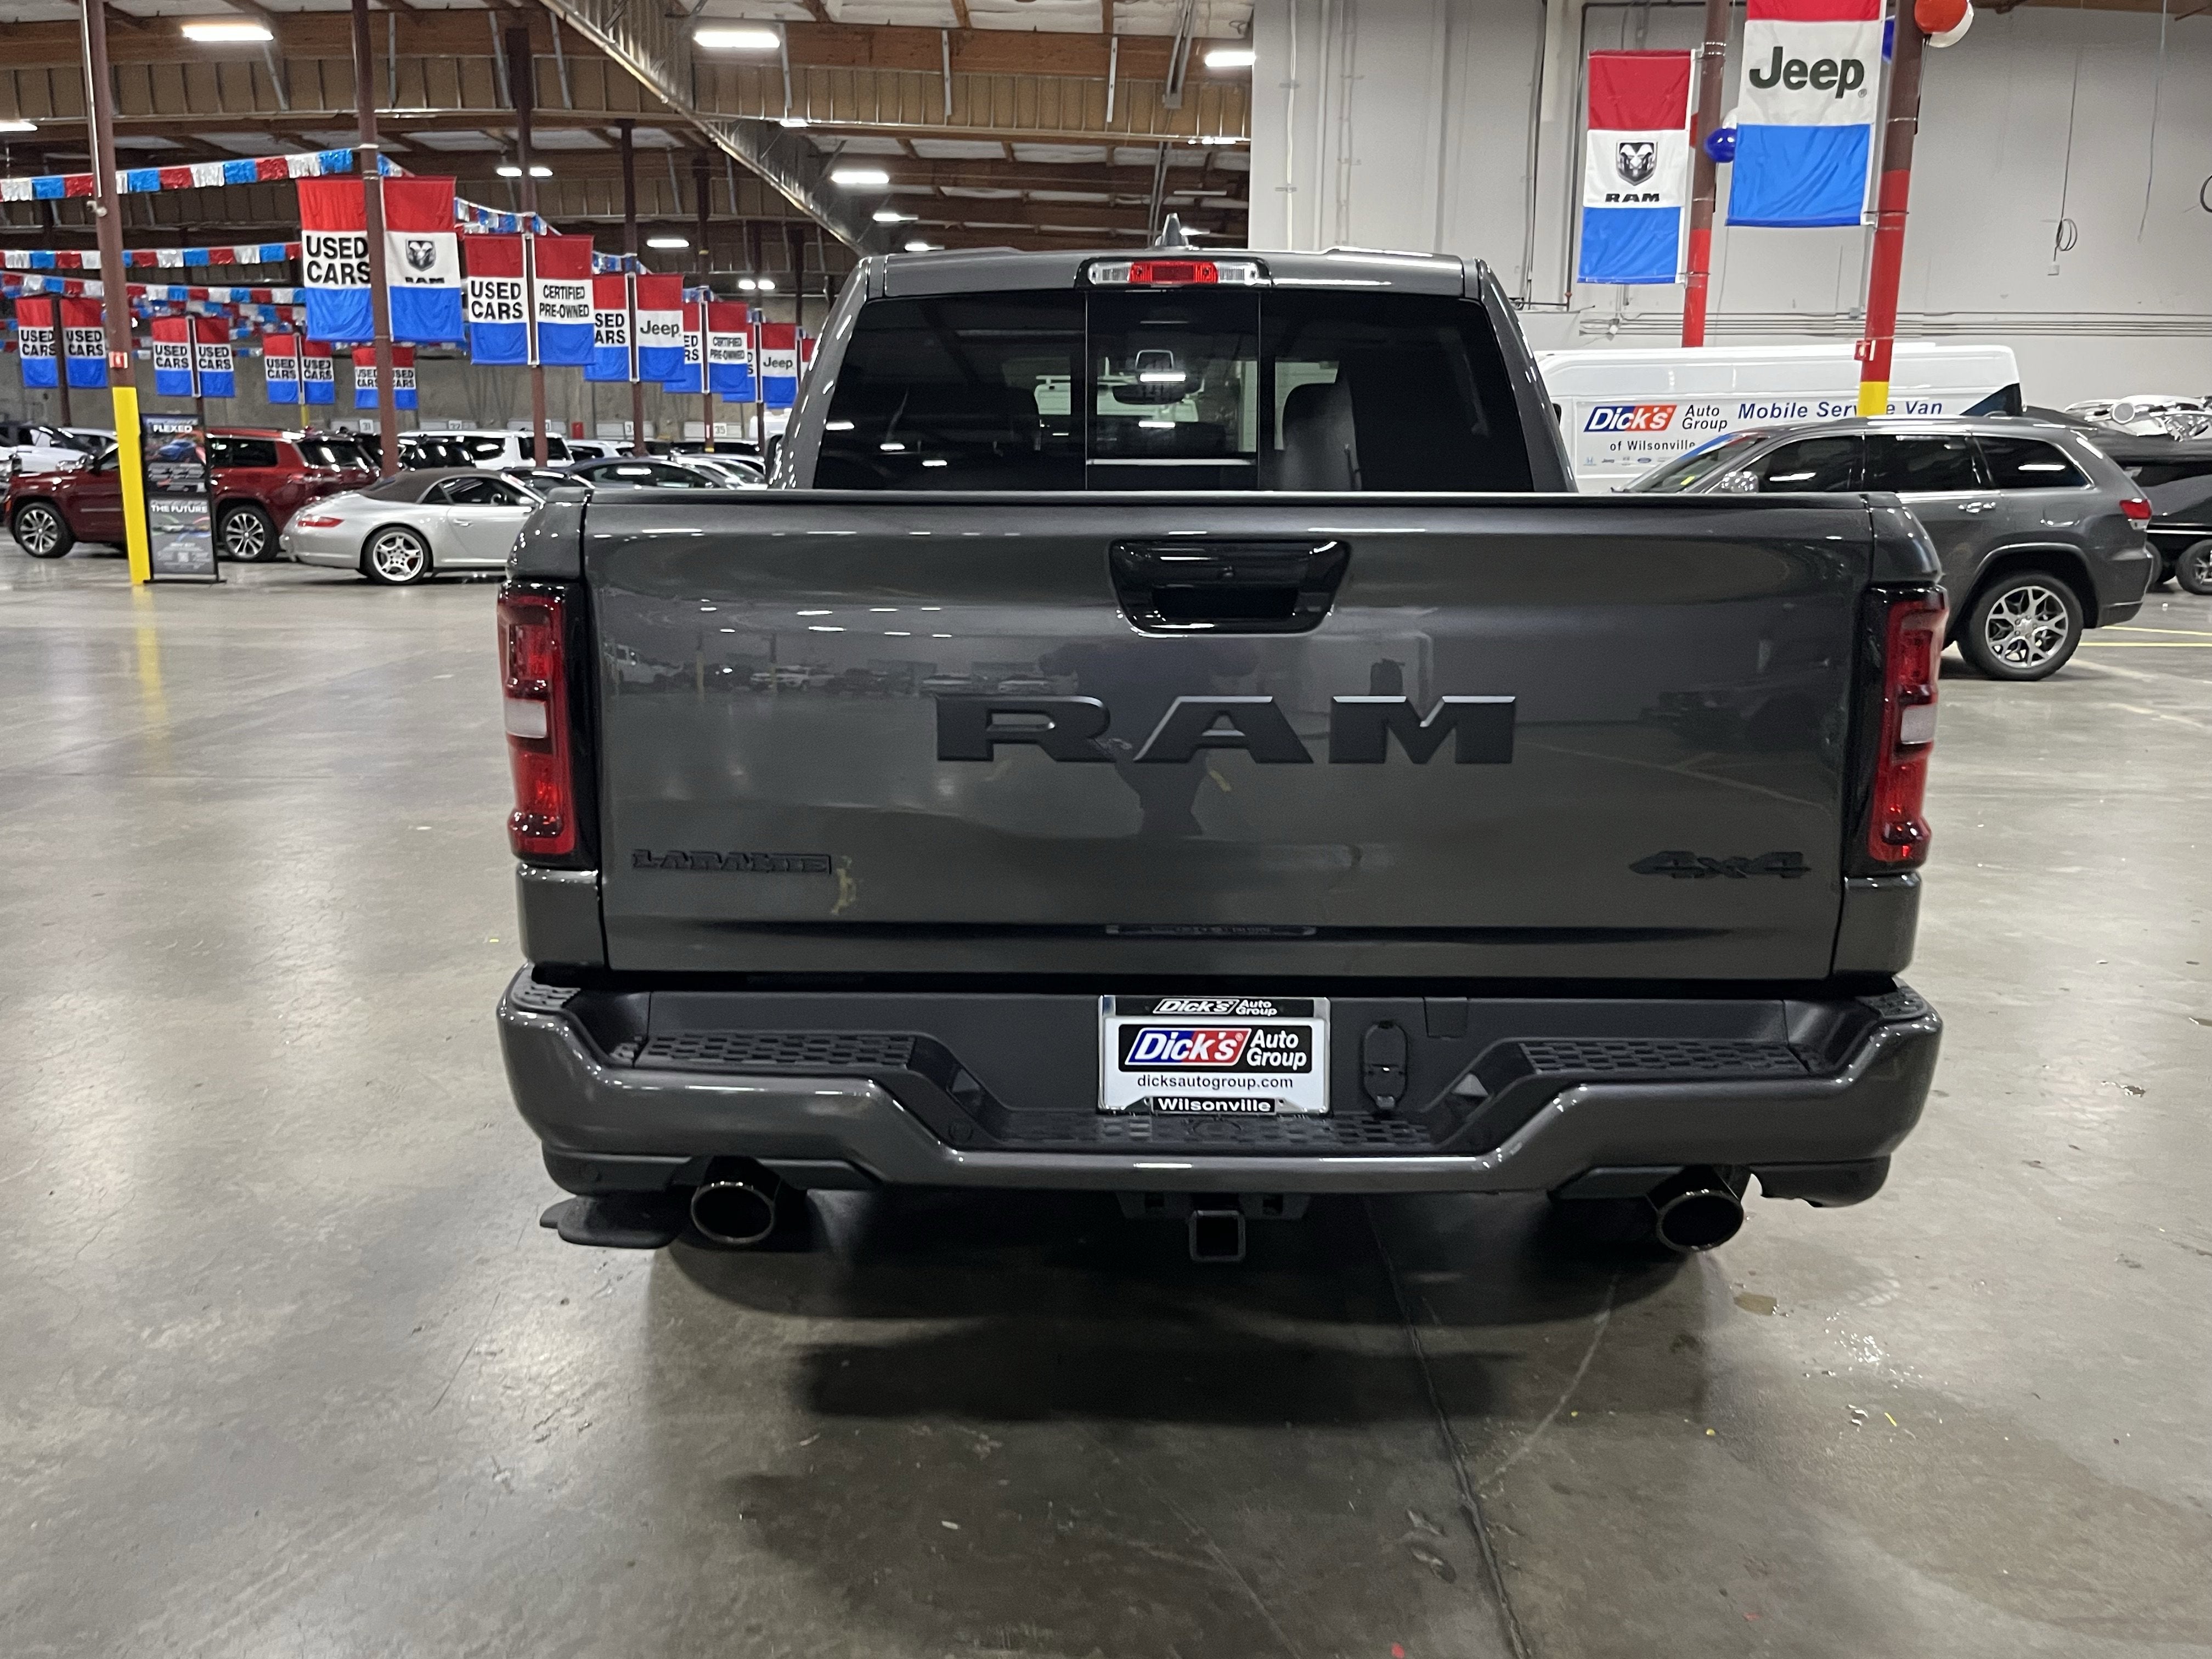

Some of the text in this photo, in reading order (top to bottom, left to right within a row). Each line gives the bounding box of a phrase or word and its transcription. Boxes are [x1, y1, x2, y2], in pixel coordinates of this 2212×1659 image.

[1749, 47, 1865, 98] Jeep
[1605, 194, 1660, 202] RAM
[306, 236, 368, 259] USED
[307, 261, 370, 284] CARS
[471, 280, 521, 300] USED
[543, 285, 585, 300] CERTIFIED
[471, 301, 523, 320] CARS
[539, 302, 589, 318] PRE-OWNED
[594, 313, 624, 328] SED
[640, 320, 679, 337] Jeep
[21, 330, 54, 342] USED
[66, 330, 102, 342] USED
[594, 330, 625, 344] ARS
[22, 343, 56, 356] CARS
[69, 344, 103, 356] CARS
[155, 345, 187, 356] USED
[199, 347, 229, 357] USED
[156, 358, 189, 368] CARS
[199, 359, 231, 369] CARS
[267, 359, 295, 368] USED
[304, 359, 331, 369] USED
[763, 357, 793, 370] Jeep
[267, 370, 296, 379] CARS
[304, 371, 332, 380] CARS
[1685, 404, 1720, 417] Auto
[1738, 402, 1808, 419] Mobile
[1905, 400, 1943, 415] Van
[1588, 407, 1668, 431] Dick's
[1682, 417, 1728, 432] Group
[1610, 440, 1695, 451] of Wilsonville
[934, 694, 1516, 764] RAM
[1158, 999, 1234, 1013] Dick's
[1240, 999, 1272, 1008] Auto
[1236, 1007, 1277, 1017] Group
[1250, 1029, 1299, 1049] Auto
[1134, 1032, 1237, 1061] Dick's
[1246, 1048, 1307, 1071] Group
[1137, 1074, 1294, 1091] dicksautogroup.com
[1158, 1098, 1272, 1113] Wilsonville
